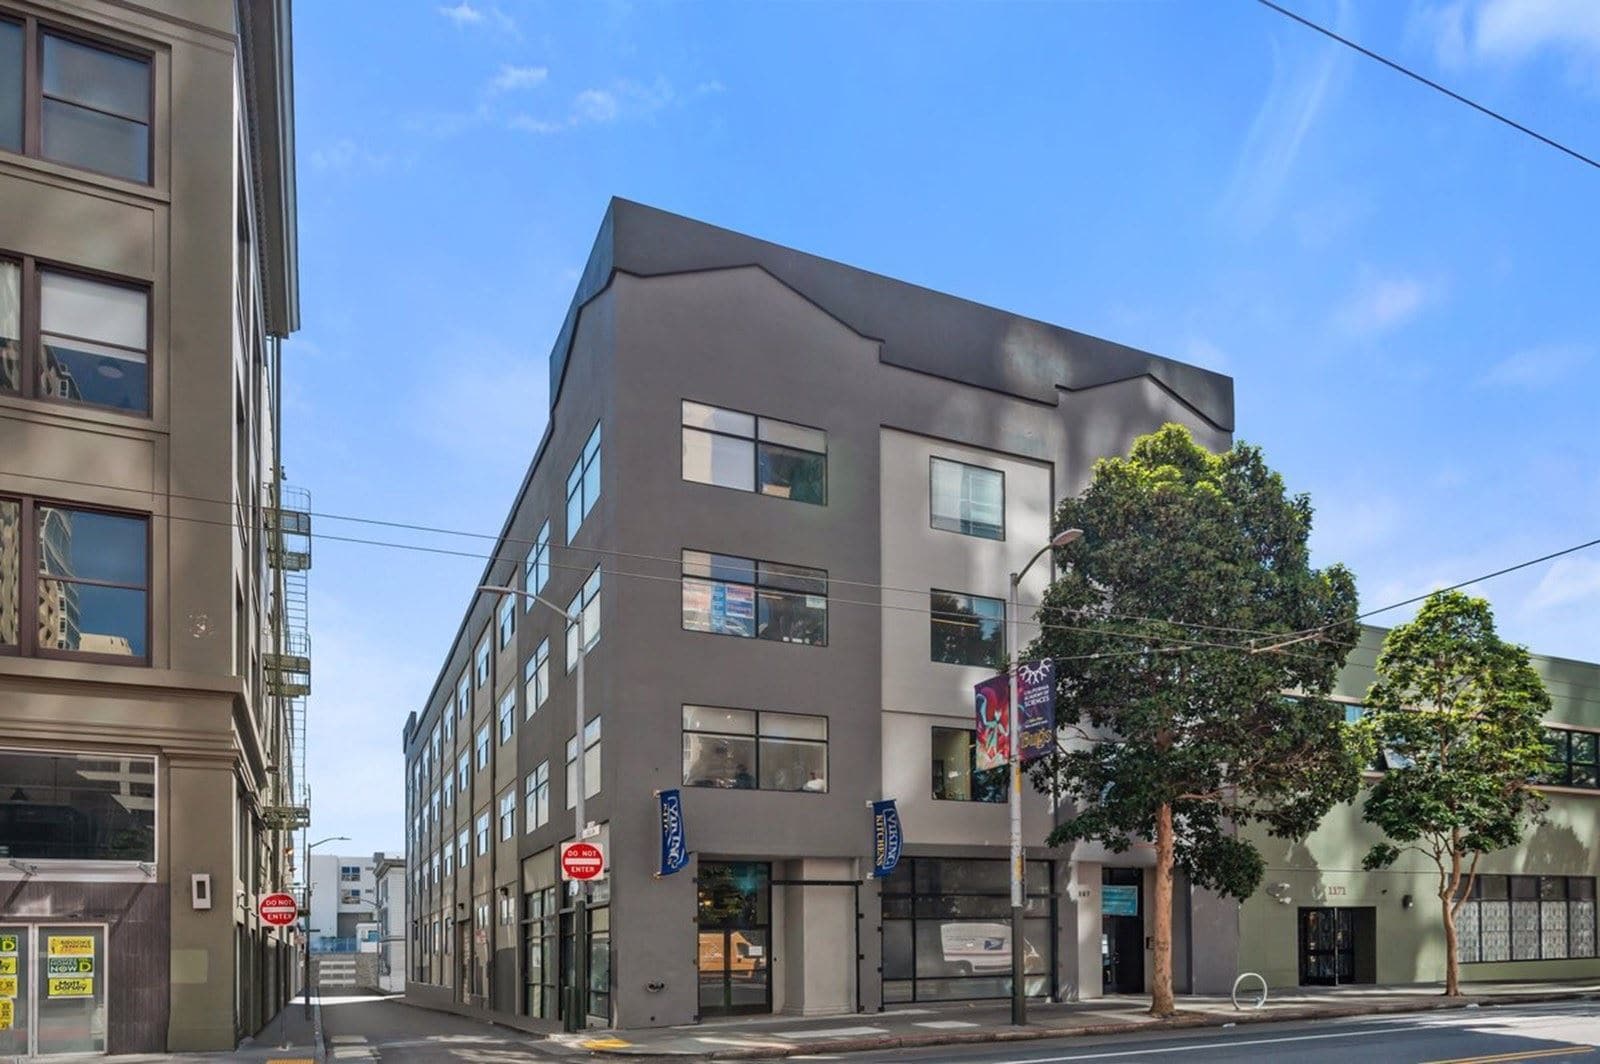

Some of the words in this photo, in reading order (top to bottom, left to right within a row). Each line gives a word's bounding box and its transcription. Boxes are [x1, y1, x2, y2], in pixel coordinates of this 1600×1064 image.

[876, 815, 885, 867] KITCHENS
[886, 812, 899, 866] VIKING
[1328, 886, 1346, 896] 1171
[51, 965, 77, 973] NOW
